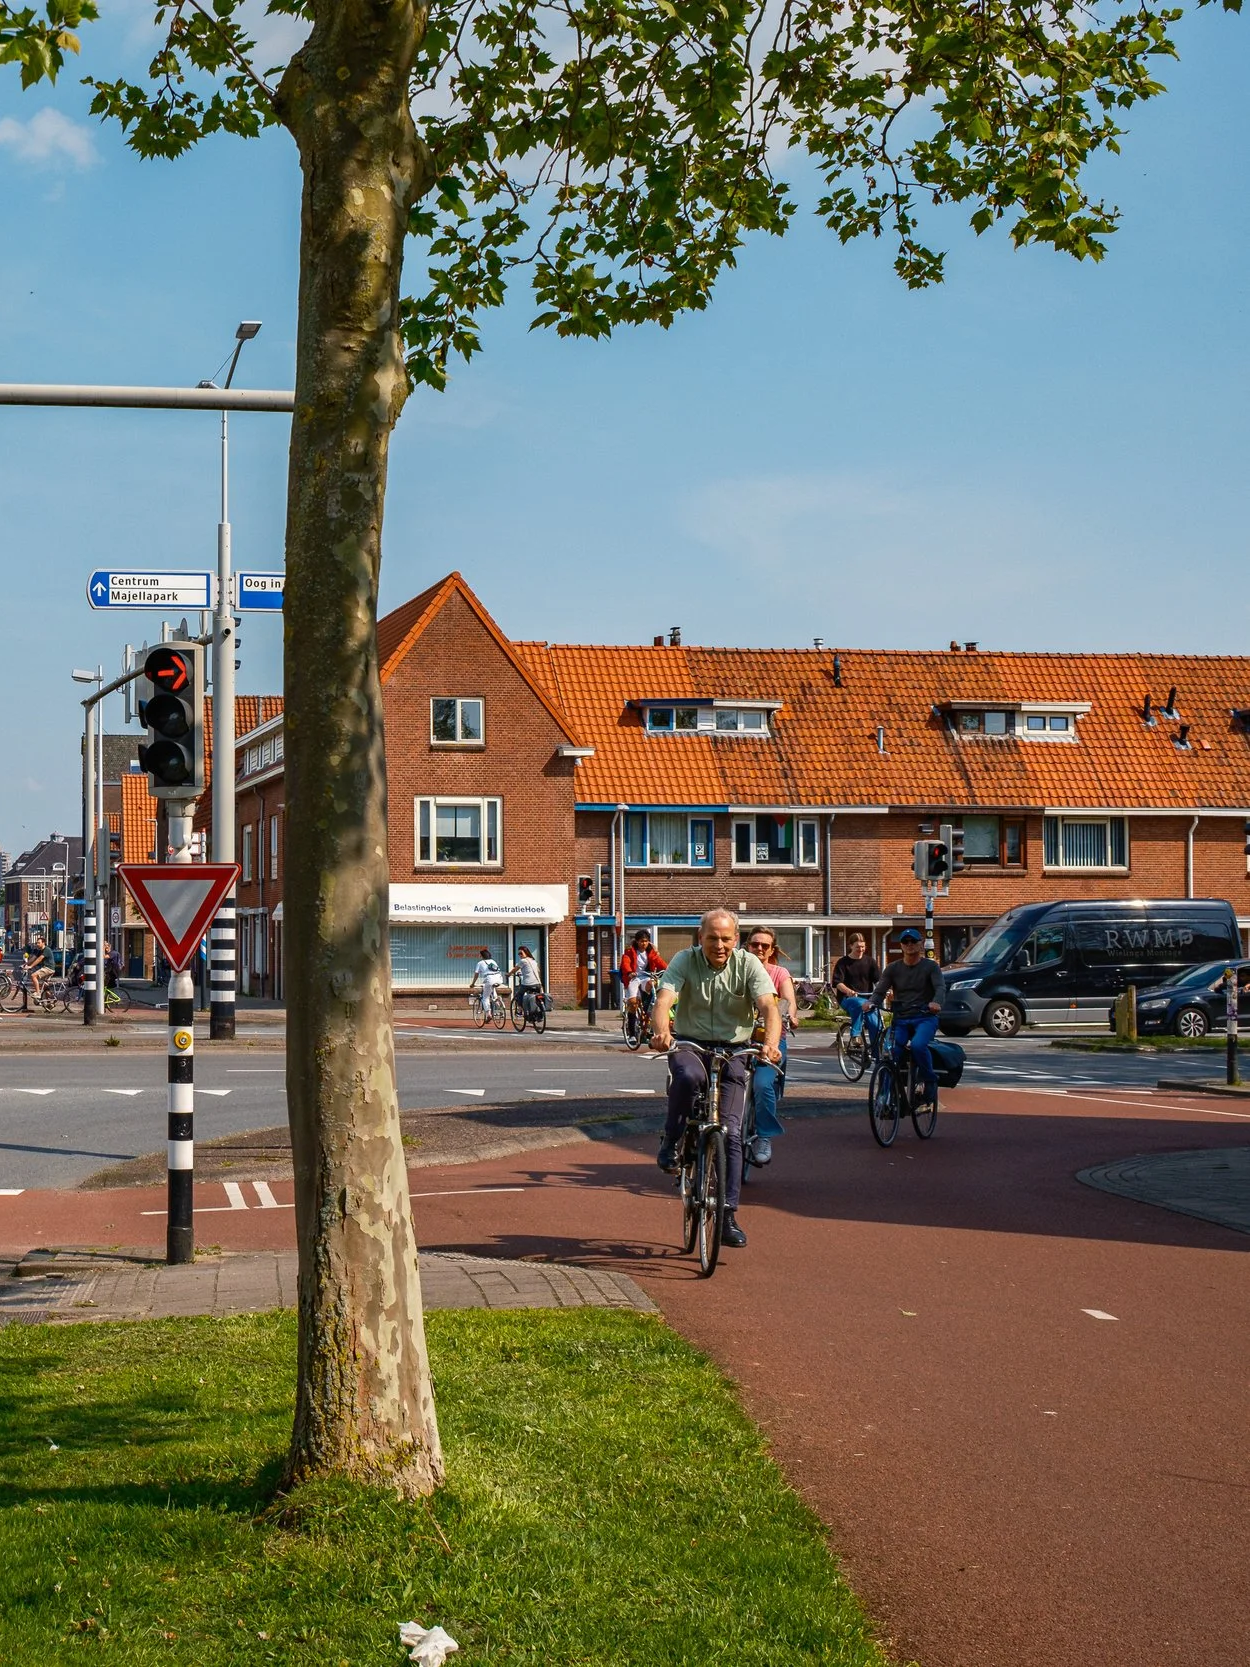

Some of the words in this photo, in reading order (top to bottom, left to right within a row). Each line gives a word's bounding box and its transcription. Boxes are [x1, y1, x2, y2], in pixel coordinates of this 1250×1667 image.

[111, 576, 159, 586] Centrum
[245, 578, 267, 590] Oog
[271, 577, 281, 589] in
[111, 591, 179, 603] Majellapark
[393, 903, 452, 912] BelastingHoek
[473, 905, 546, 914] AdministratieHoek
